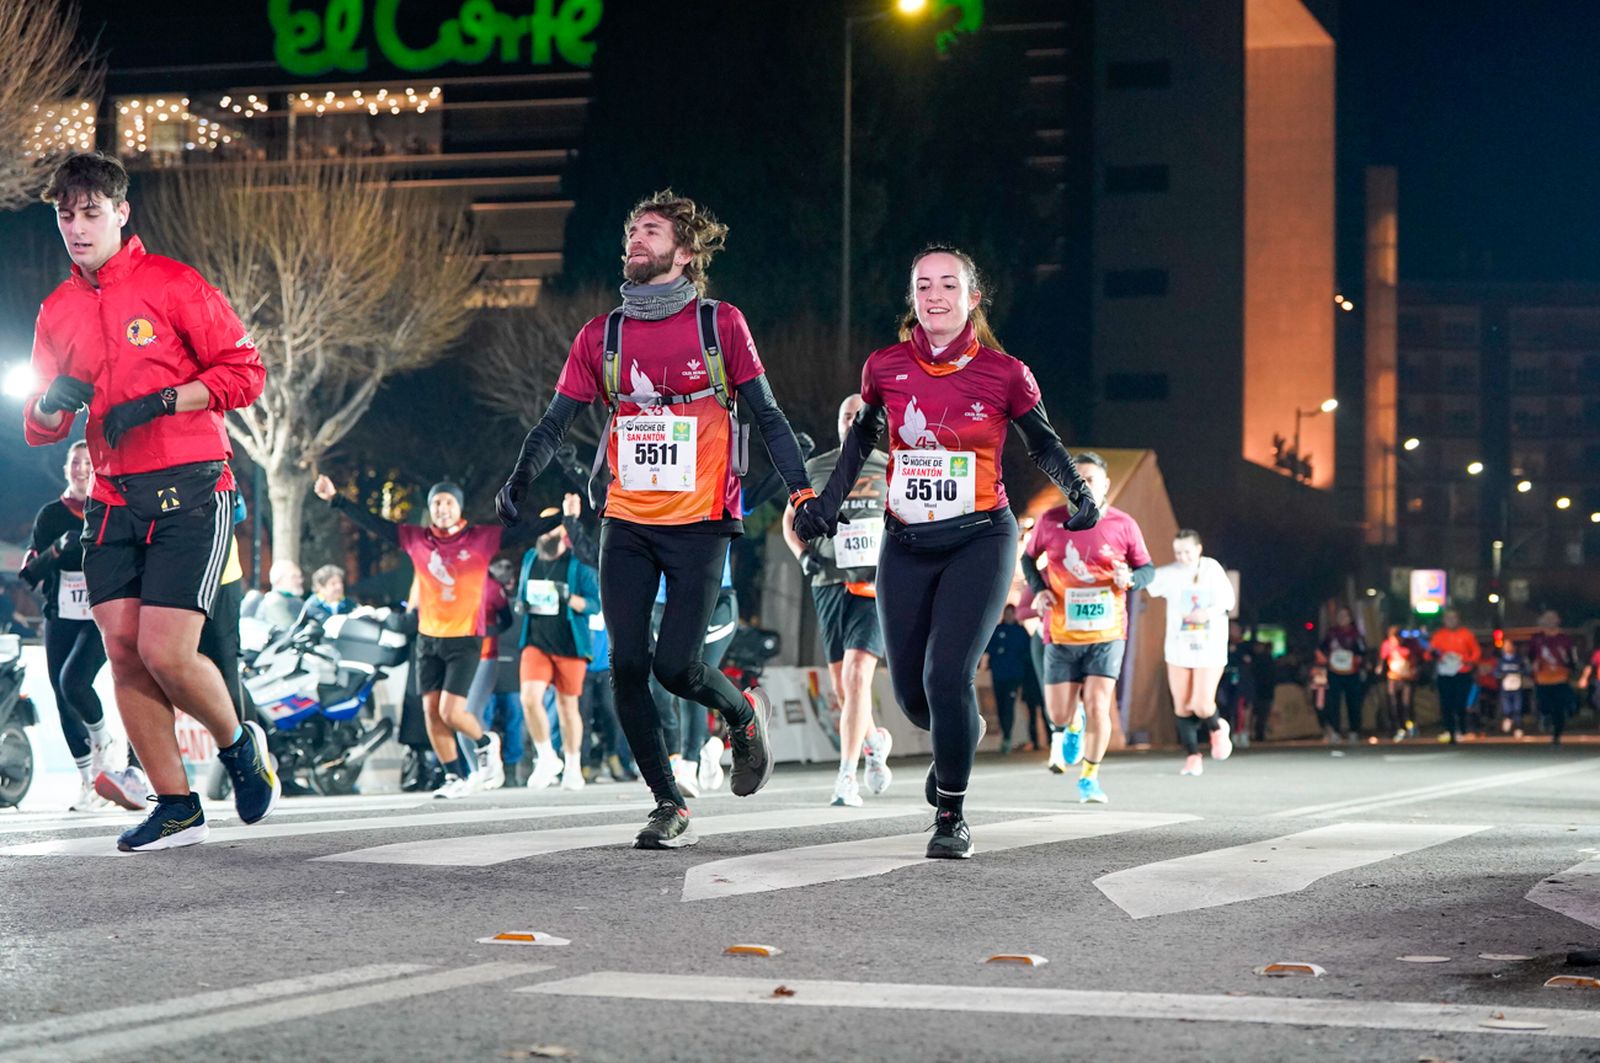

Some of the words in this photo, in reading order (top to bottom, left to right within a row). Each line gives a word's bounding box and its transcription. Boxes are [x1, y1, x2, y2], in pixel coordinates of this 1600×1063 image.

[268, 0, 368, 76] El
[374, 0, 604, 72] Corte
[626, 433, 641, 441] SAN
[635, 443, 677, 465] 5511
[910, 459, 931, 467] NOCHE
[932, 459, 943, 467] DE
[902, 468, 915, 476] SAN
[905, 478, 957, 501] 5510
[844, 536, 877, 550] 4306
[1075, 603, 1105, 617] 7425
